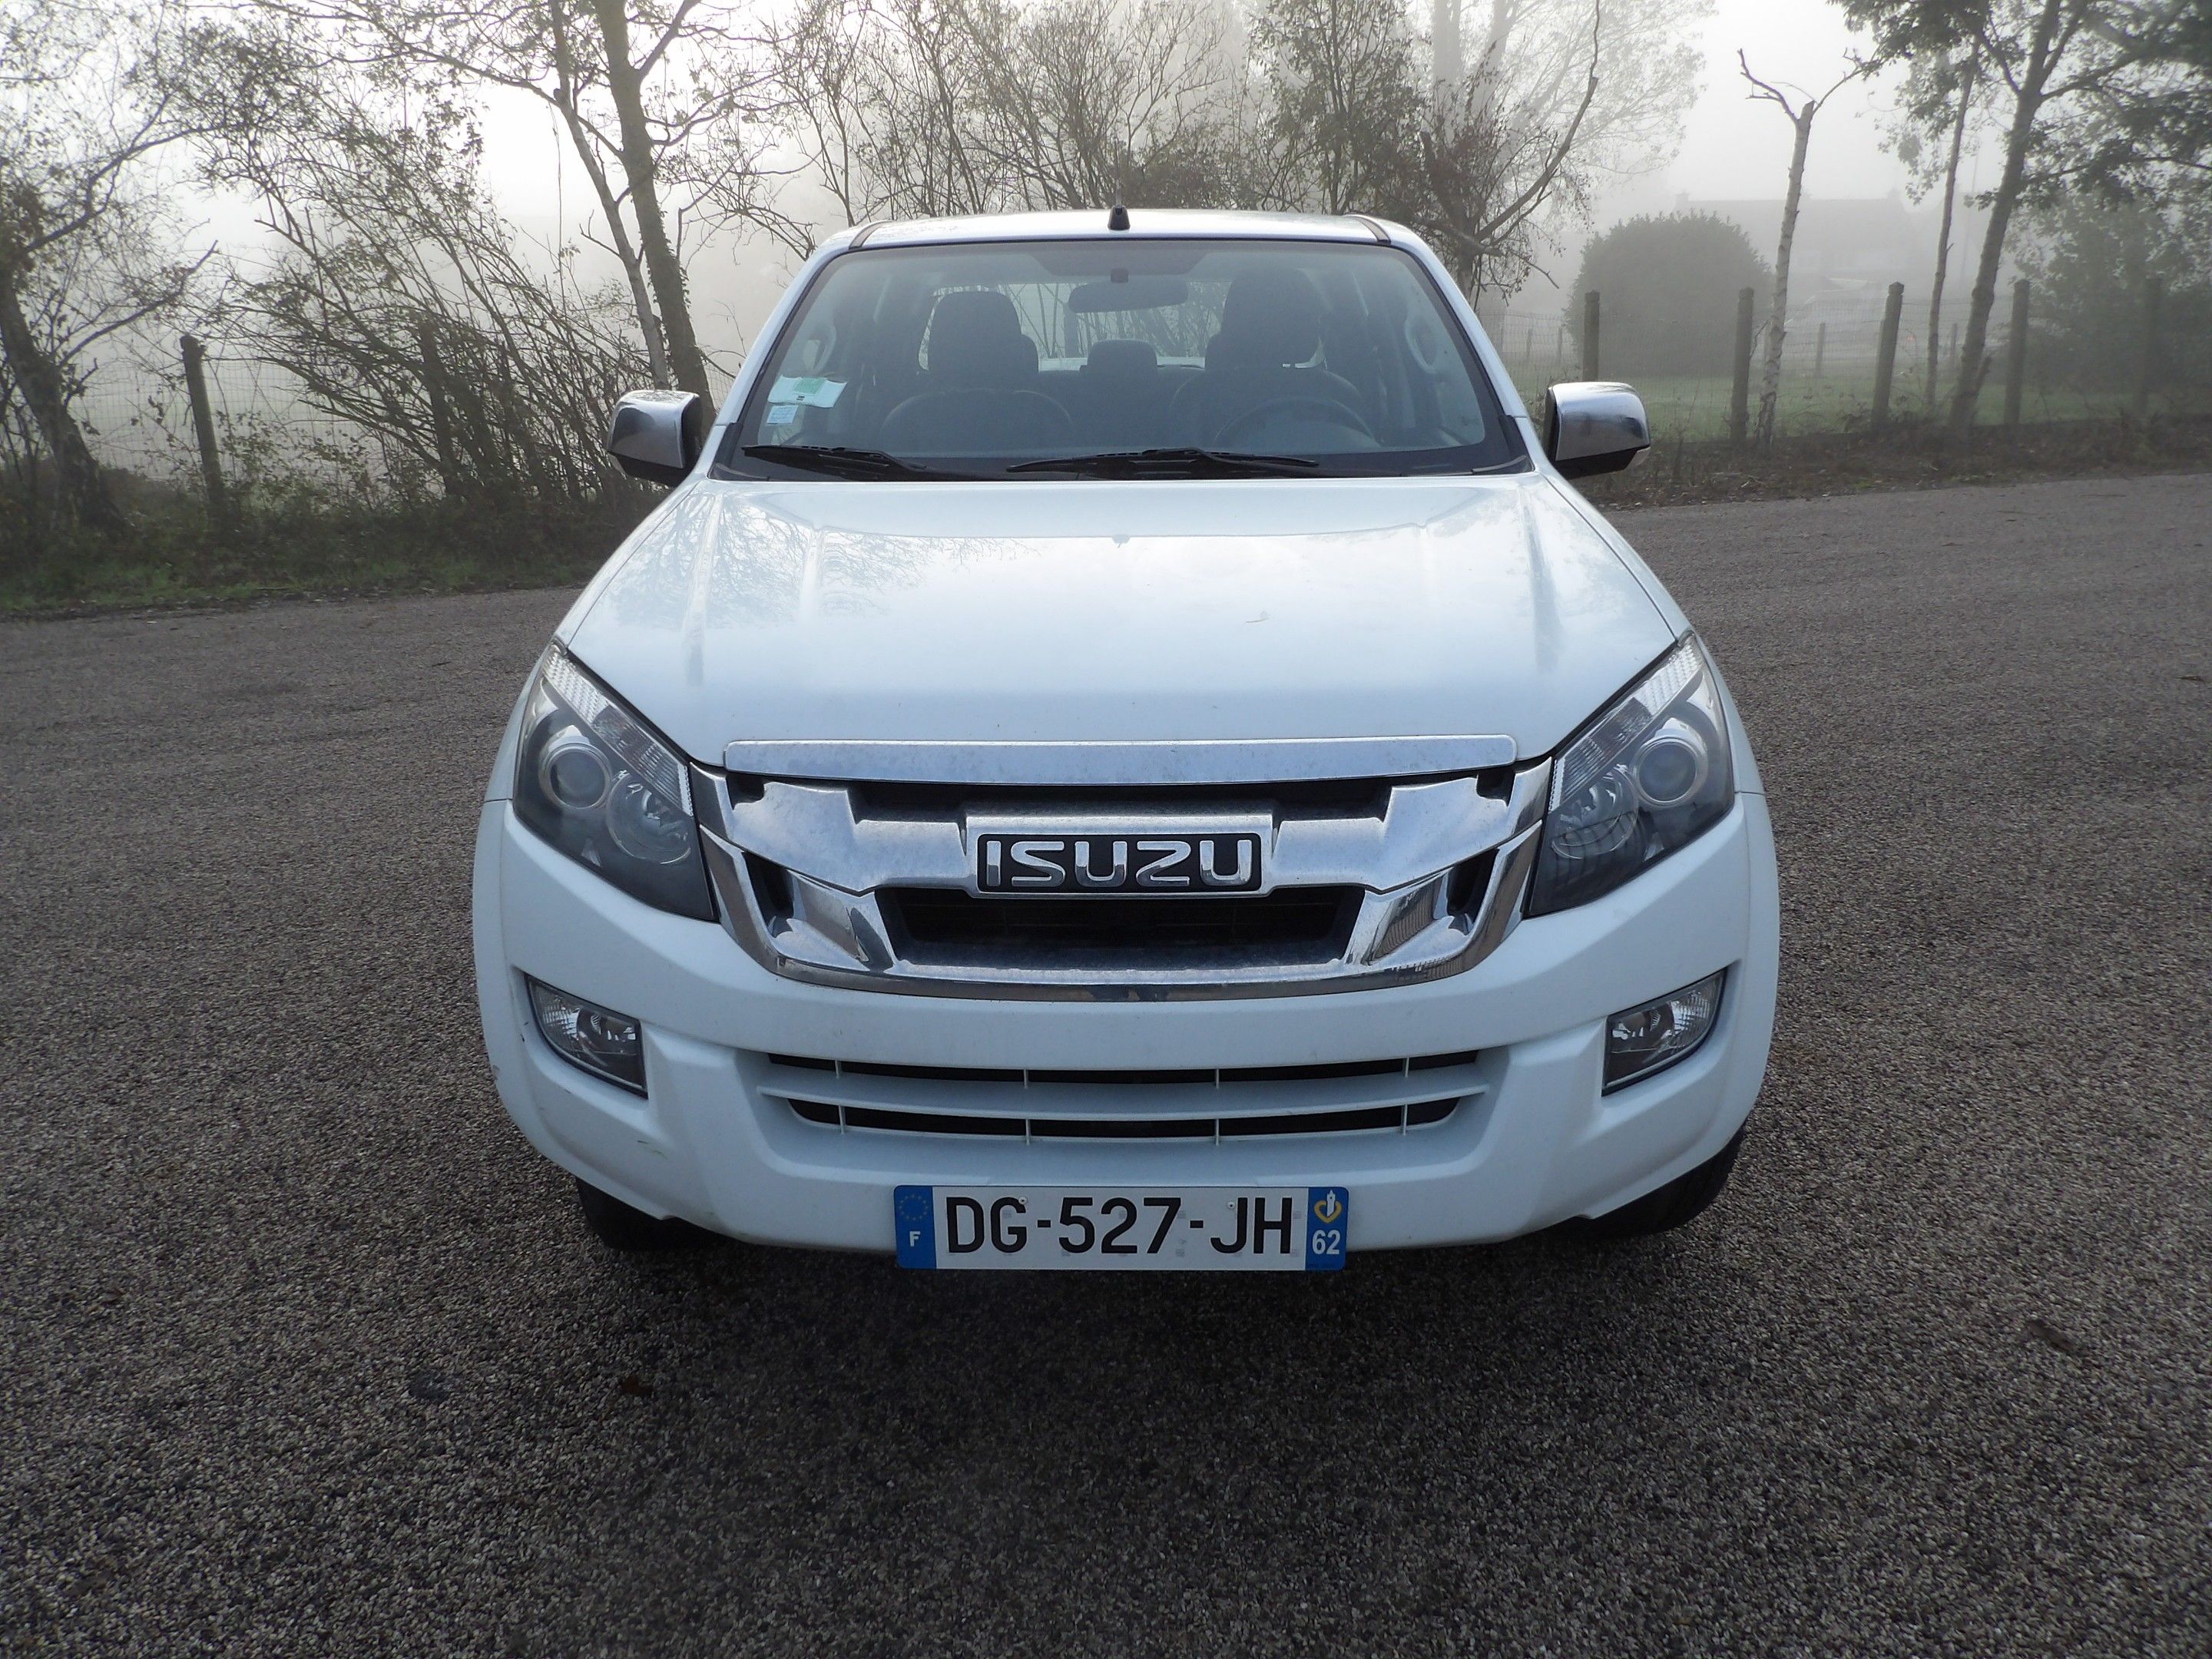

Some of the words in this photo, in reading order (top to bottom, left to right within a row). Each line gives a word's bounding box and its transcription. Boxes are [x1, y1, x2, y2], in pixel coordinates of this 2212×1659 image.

[986, 839, 1252, 887] ISUZU
[909, 1230, 921, 1247] F
[945, 1197, 1293, 1254] DG-527-JH
[1312, 1229, 1340, 1255] 62
